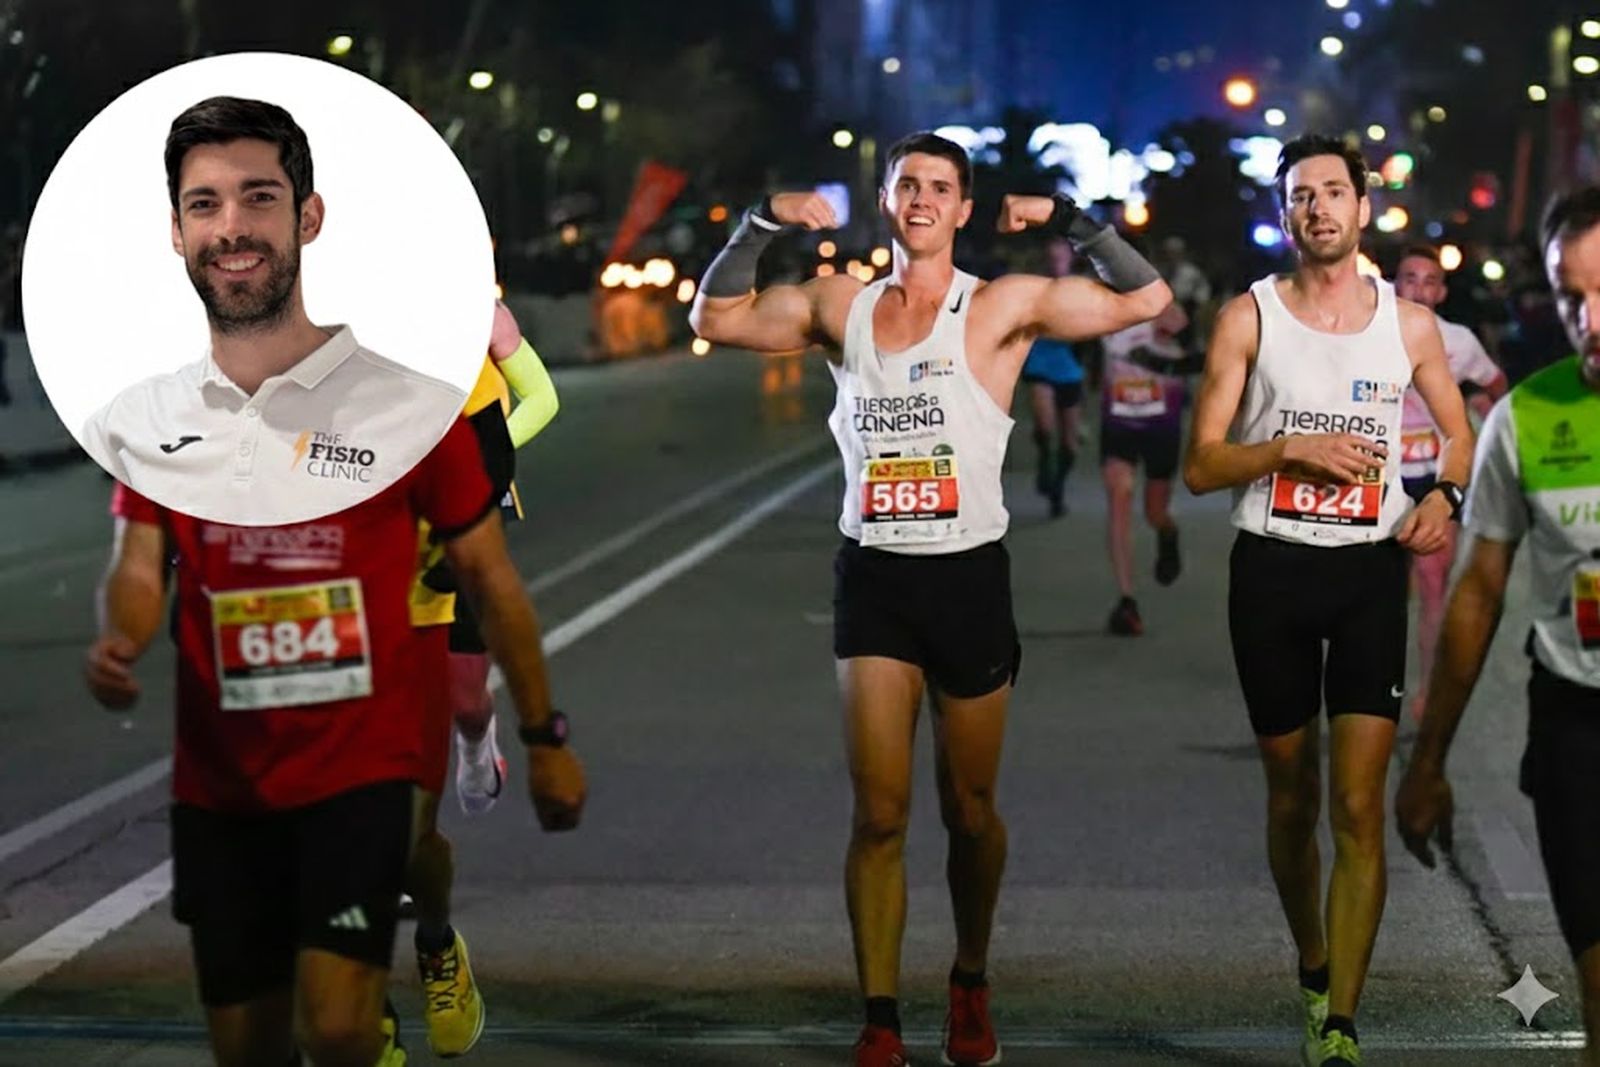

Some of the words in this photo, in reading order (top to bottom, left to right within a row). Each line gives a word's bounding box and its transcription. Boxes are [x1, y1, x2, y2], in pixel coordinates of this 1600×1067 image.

[309, 442, 375, 467] FISIO
[307, 461, 372, 483] CLINIC
[872, 481, 941, 513] 565
[1293, 482, 1365, 517] 624
[239, 617, 339, 666] 684
